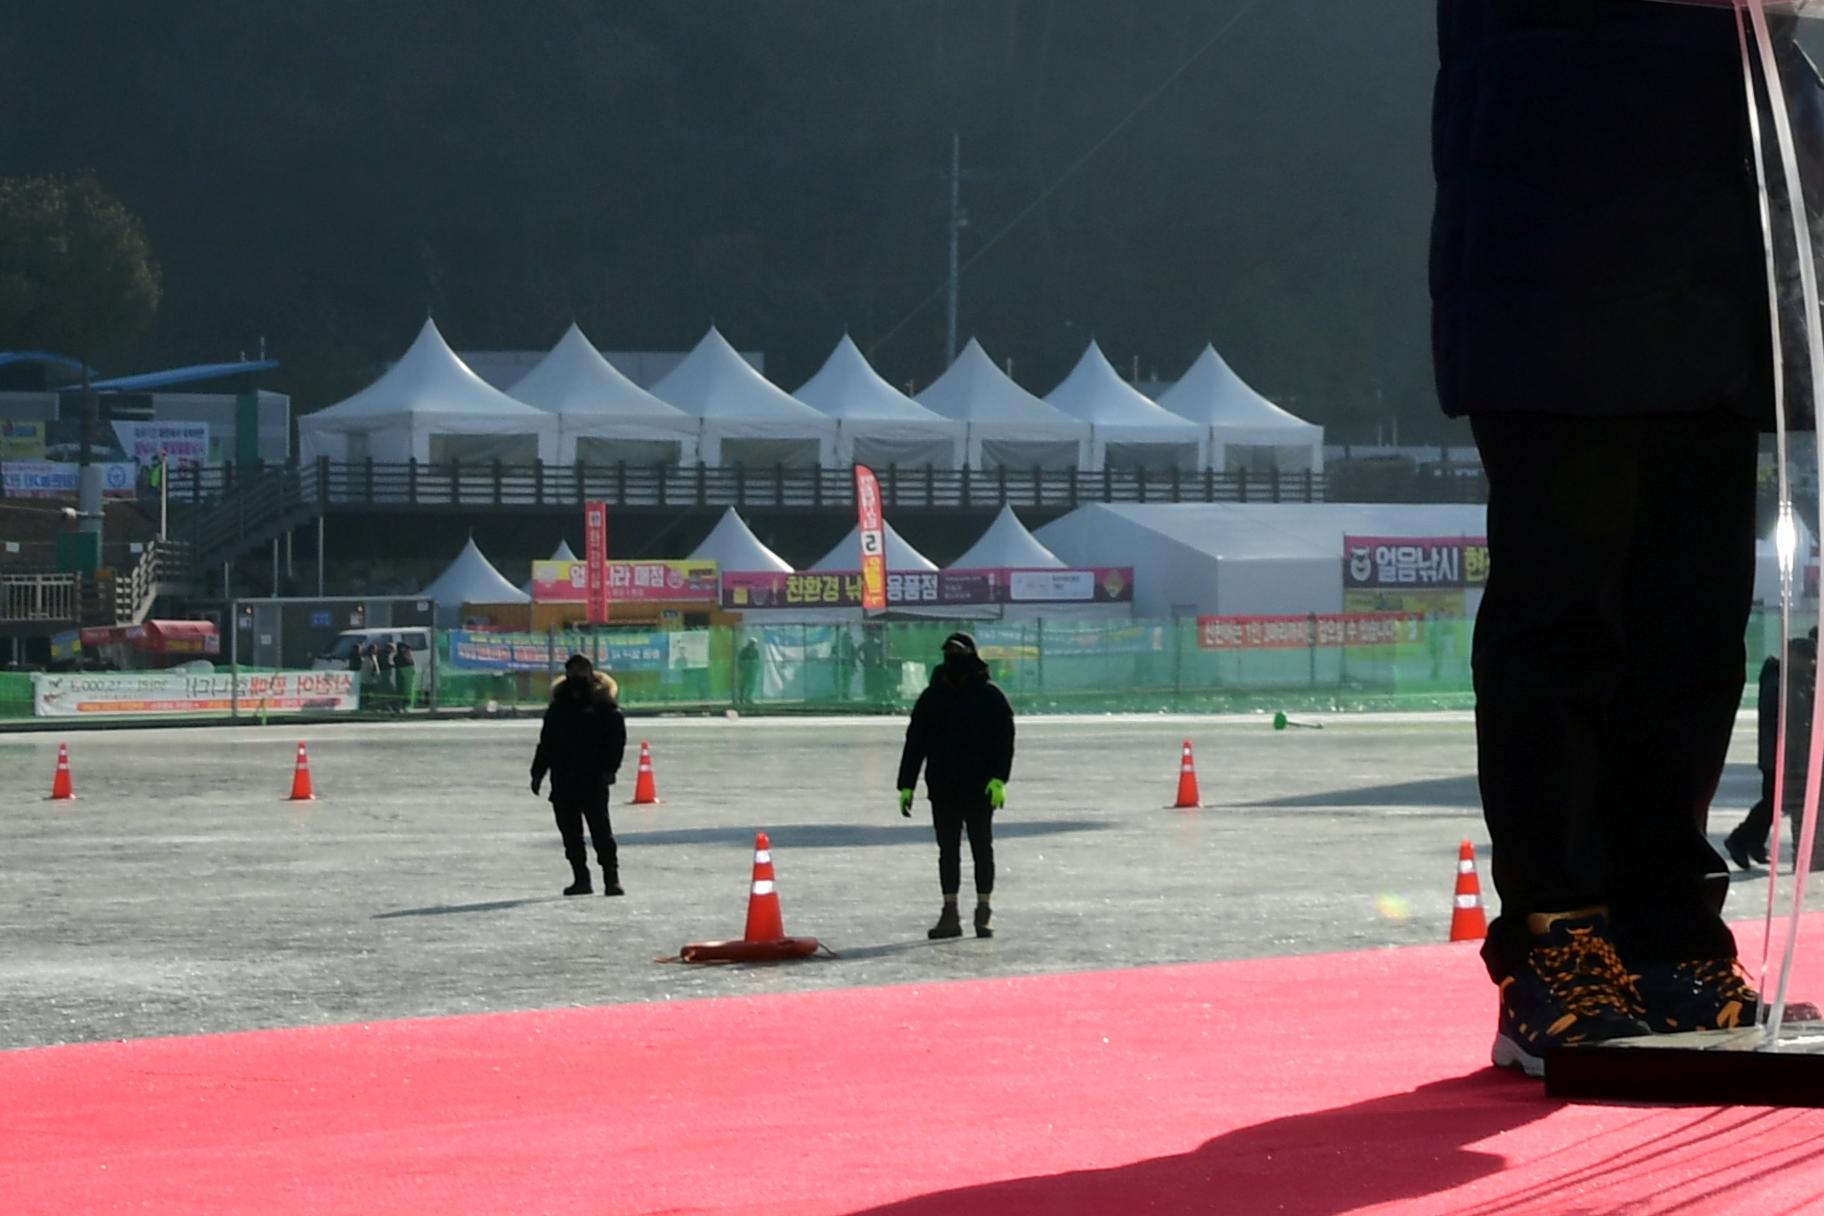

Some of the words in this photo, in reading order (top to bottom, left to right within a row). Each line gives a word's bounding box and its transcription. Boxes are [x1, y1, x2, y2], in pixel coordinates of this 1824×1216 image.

[1376, 546, 1459, 583] 얼음낚시
[1465, 546, 1490, 582] 현
[786, 575, 839, 603] 친환경
[887, 575, 938, 602] 용품점
